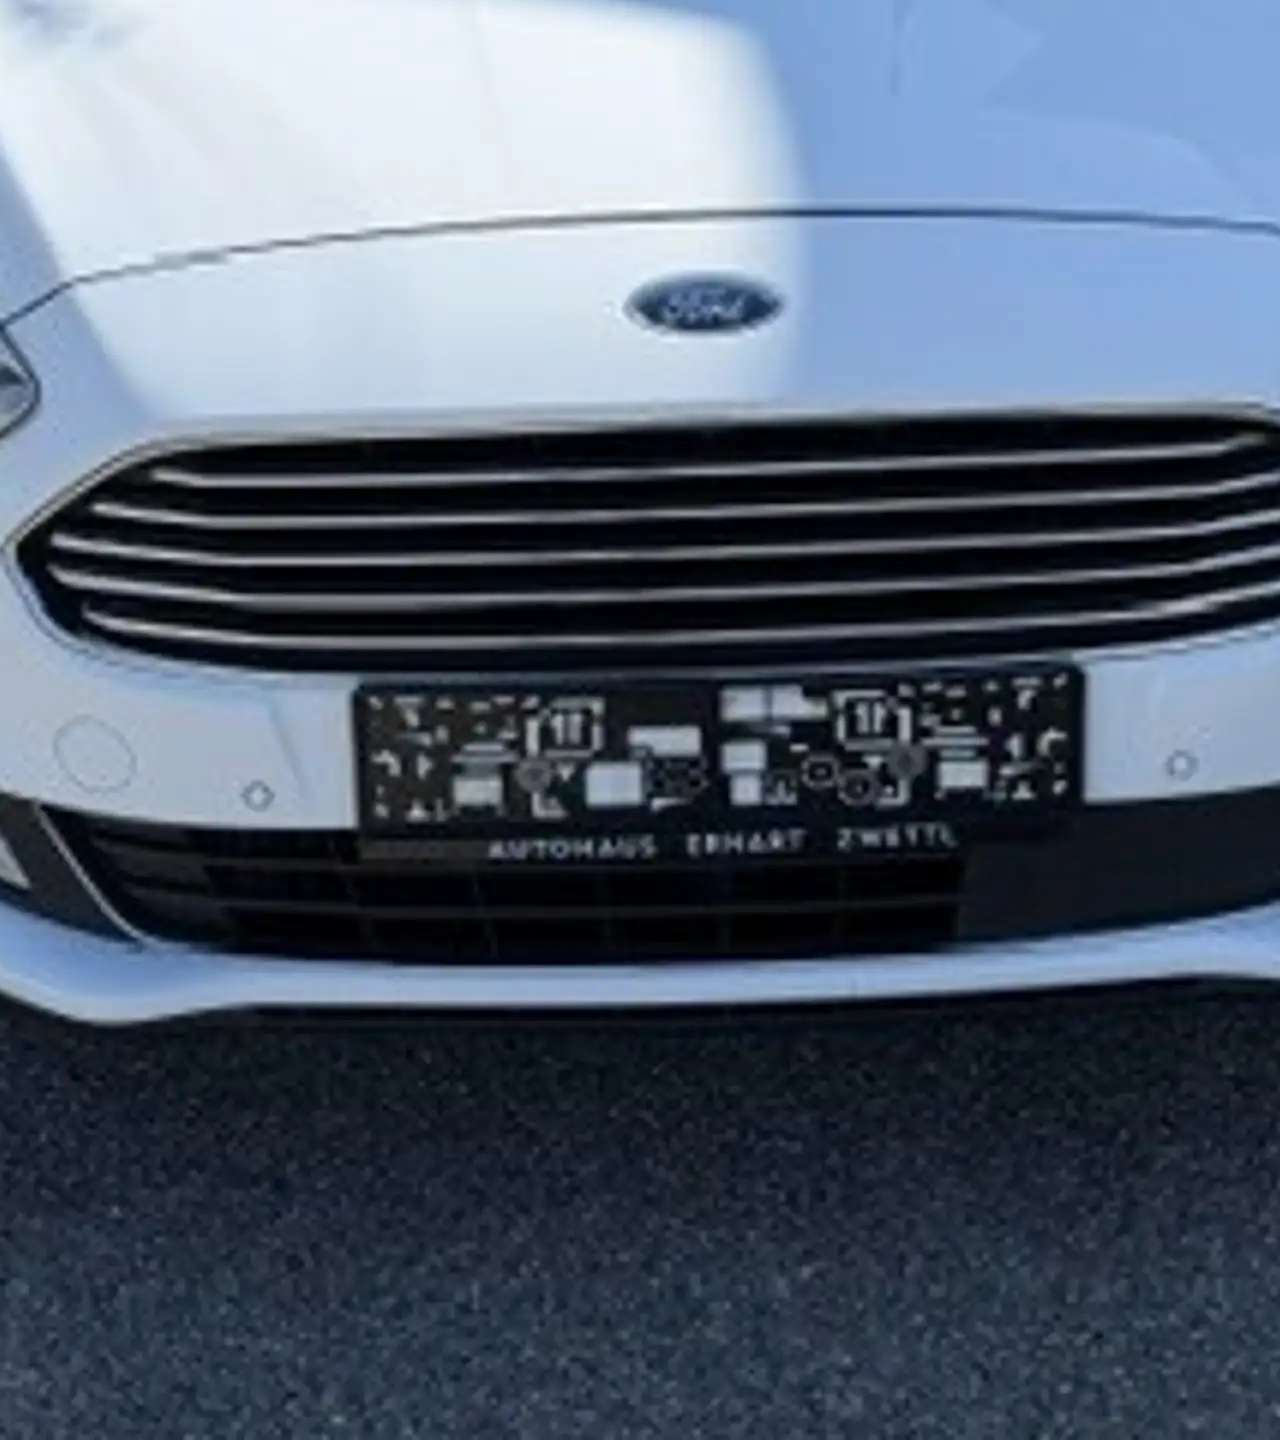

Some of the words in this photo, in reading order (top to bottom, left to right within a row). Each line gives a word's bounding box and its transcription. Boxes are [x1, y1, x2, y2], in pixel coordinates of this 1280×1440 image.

[487, 832, 658, 860] AUTOHAUS
[685, 828, 807, 858] ERHART
[835, 820, 959, 854] ZWETTL
